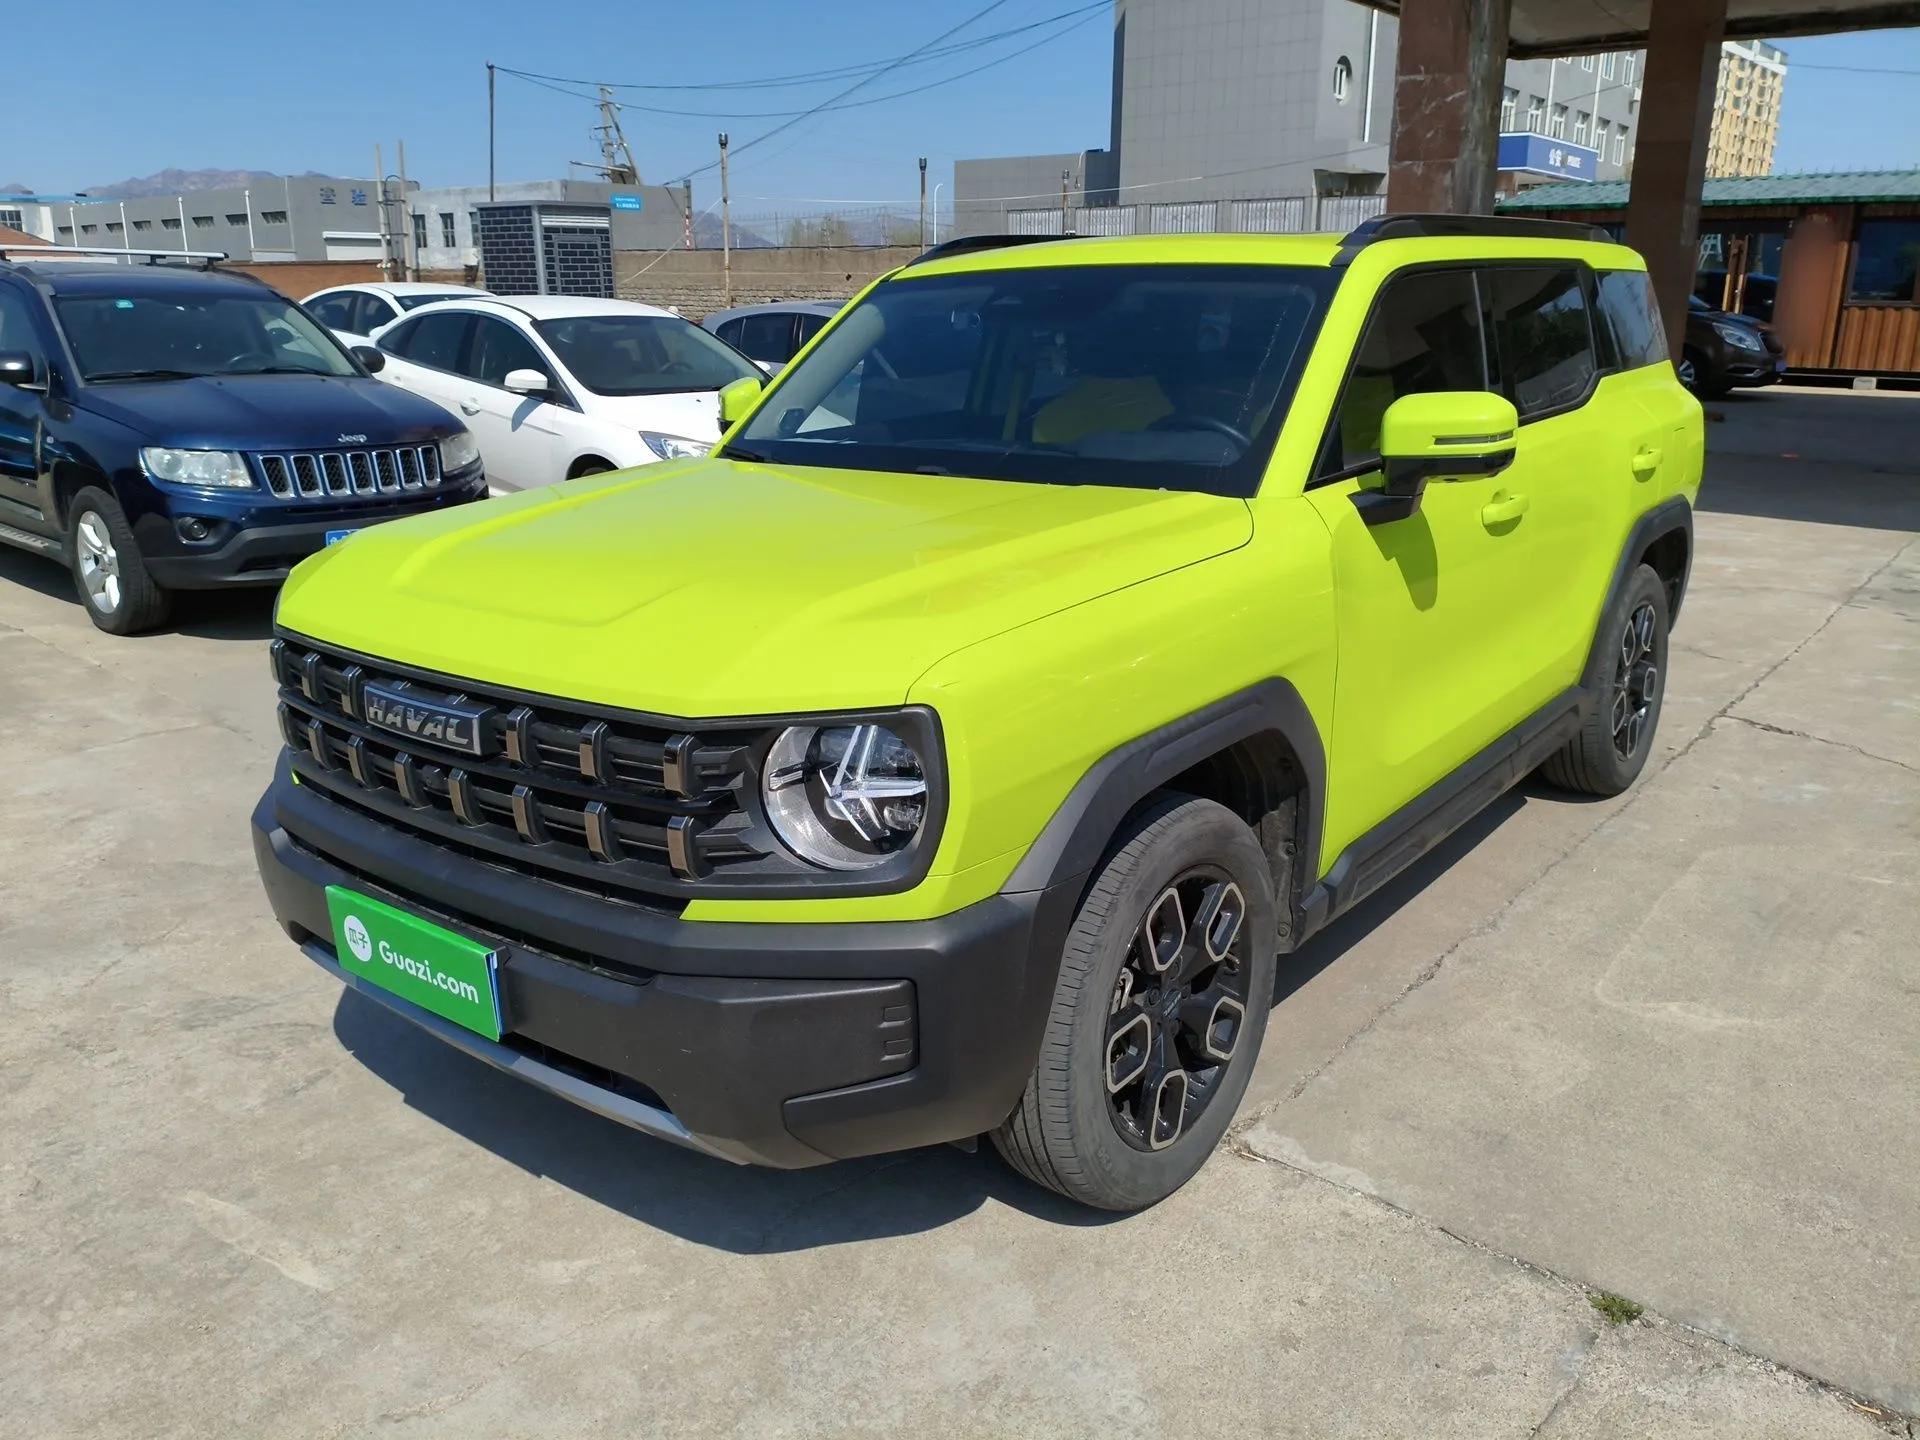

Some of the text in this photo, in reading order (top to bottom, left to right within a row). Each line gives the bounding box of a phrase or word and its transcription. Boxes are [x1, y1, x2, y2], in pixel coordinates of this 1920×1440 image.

[337, 433, 367, 443] Jeep
[368, 697, 469, 745] HAVAL
[348, 927, 368, 949] 瓜子
[378, 940, 479, 1004] Guazi.com
